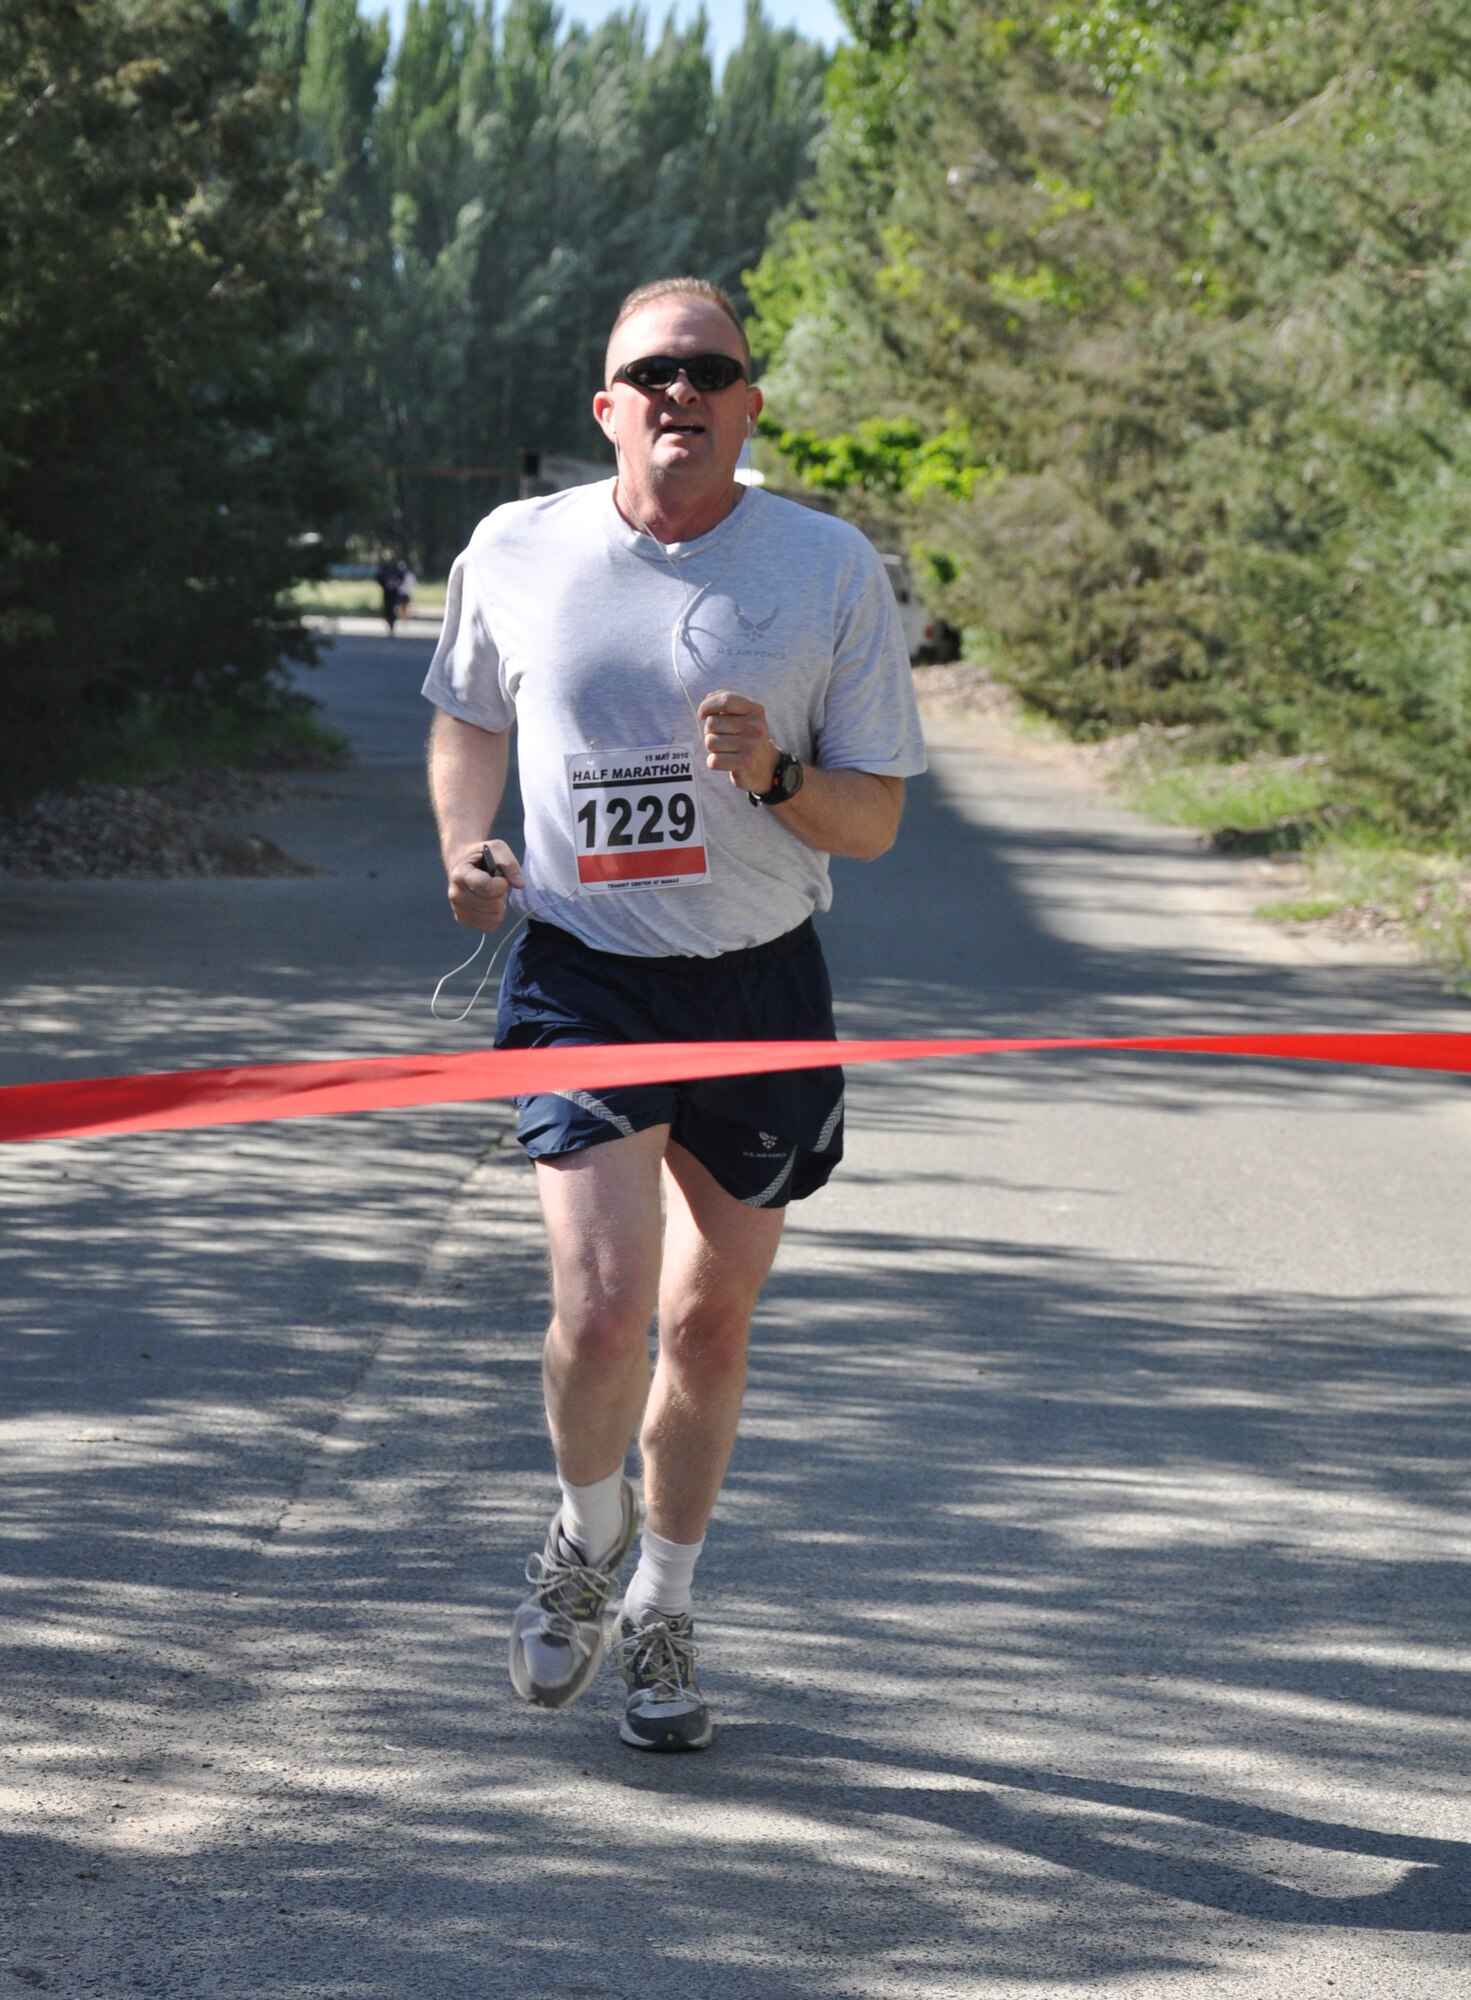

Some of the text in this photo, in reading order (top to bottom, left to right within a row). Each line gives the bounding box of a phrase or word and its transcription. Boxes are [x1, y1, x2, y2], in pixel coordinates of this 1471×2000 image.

[645, 752, 689, 762] 15 MAY 2010
[572, 763, 690, 782] HALF MARATHON
[578, 793, 695, 848] 1229
